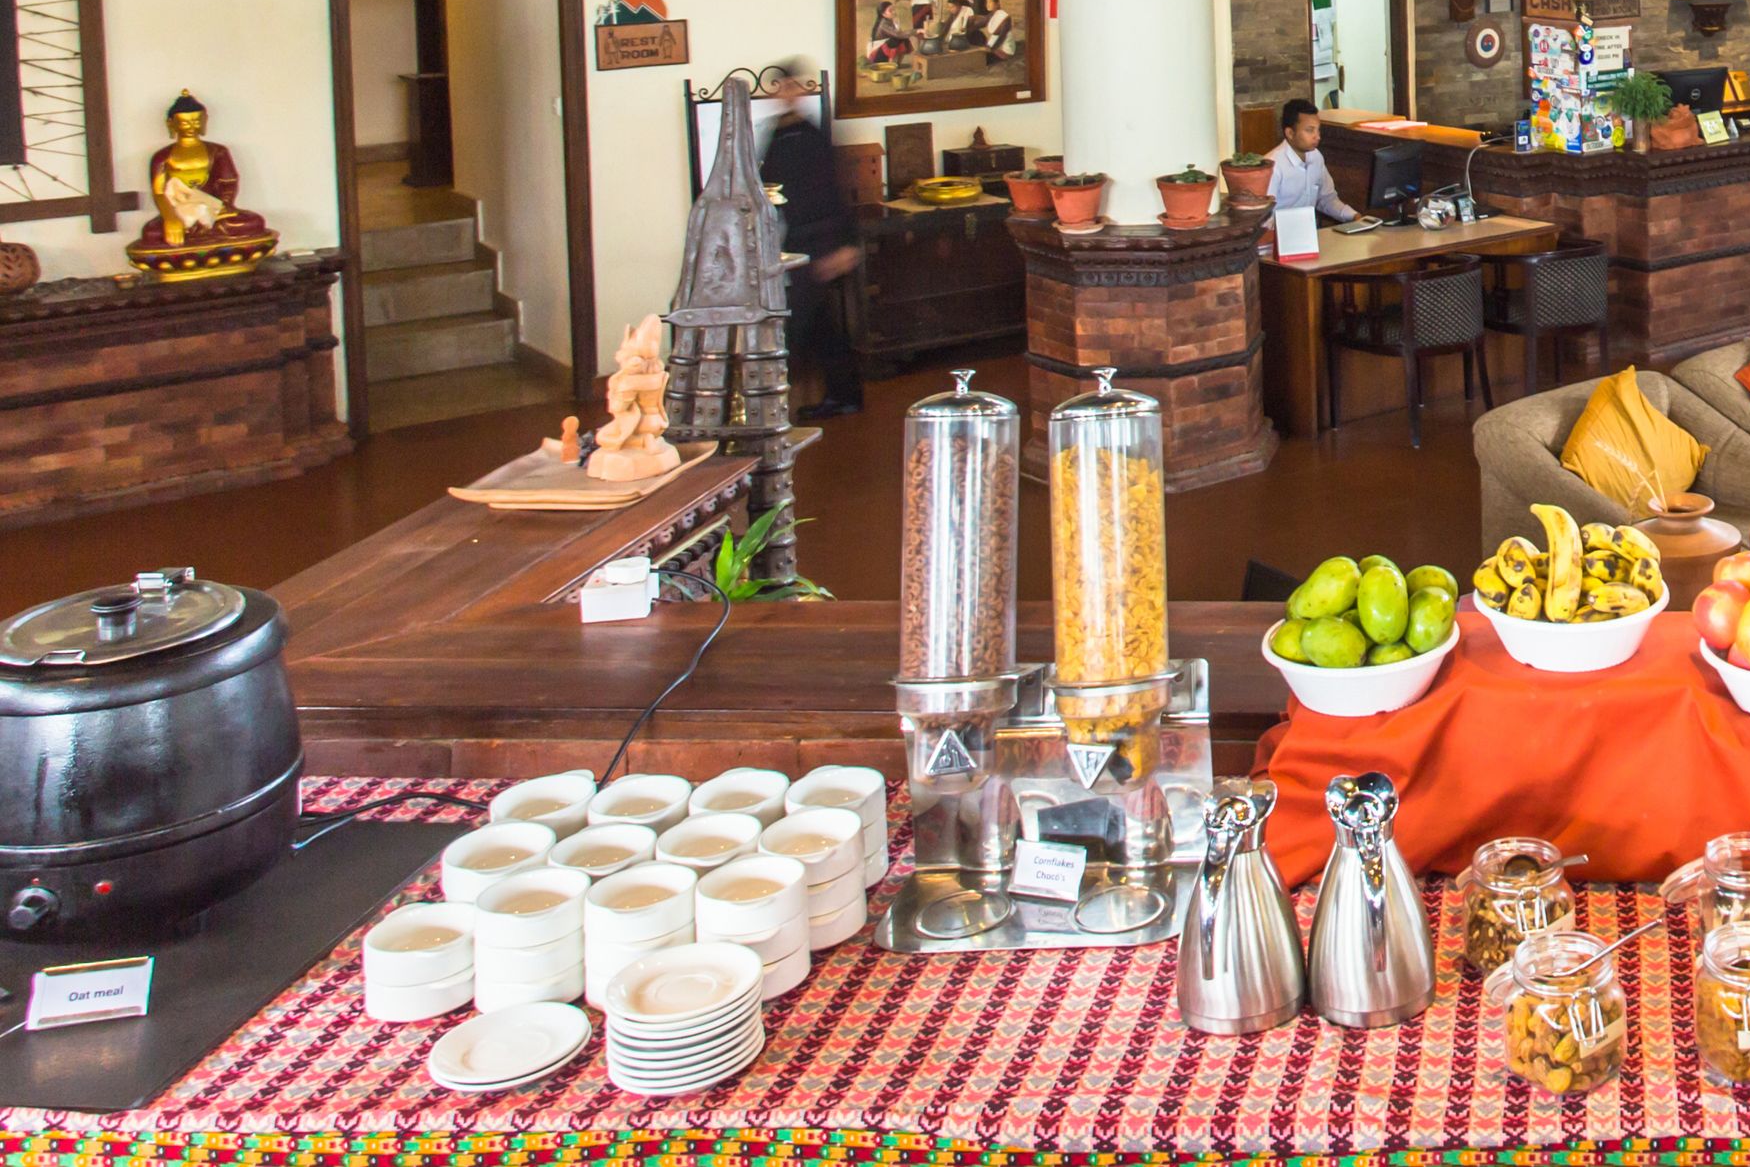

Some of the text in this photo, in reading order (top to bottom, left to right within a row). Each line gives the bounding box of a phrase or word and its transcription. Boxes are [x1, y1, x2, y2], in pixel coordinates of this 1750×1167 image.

[620, 36, 658, 47] REST
[620, 49, 659, 59] ROOM
[1033, 856, 1075, 868] Cornflakes
[1036, 871, 1066, 882] Choco's
[68, 985, 124, 1002] Oat meal
